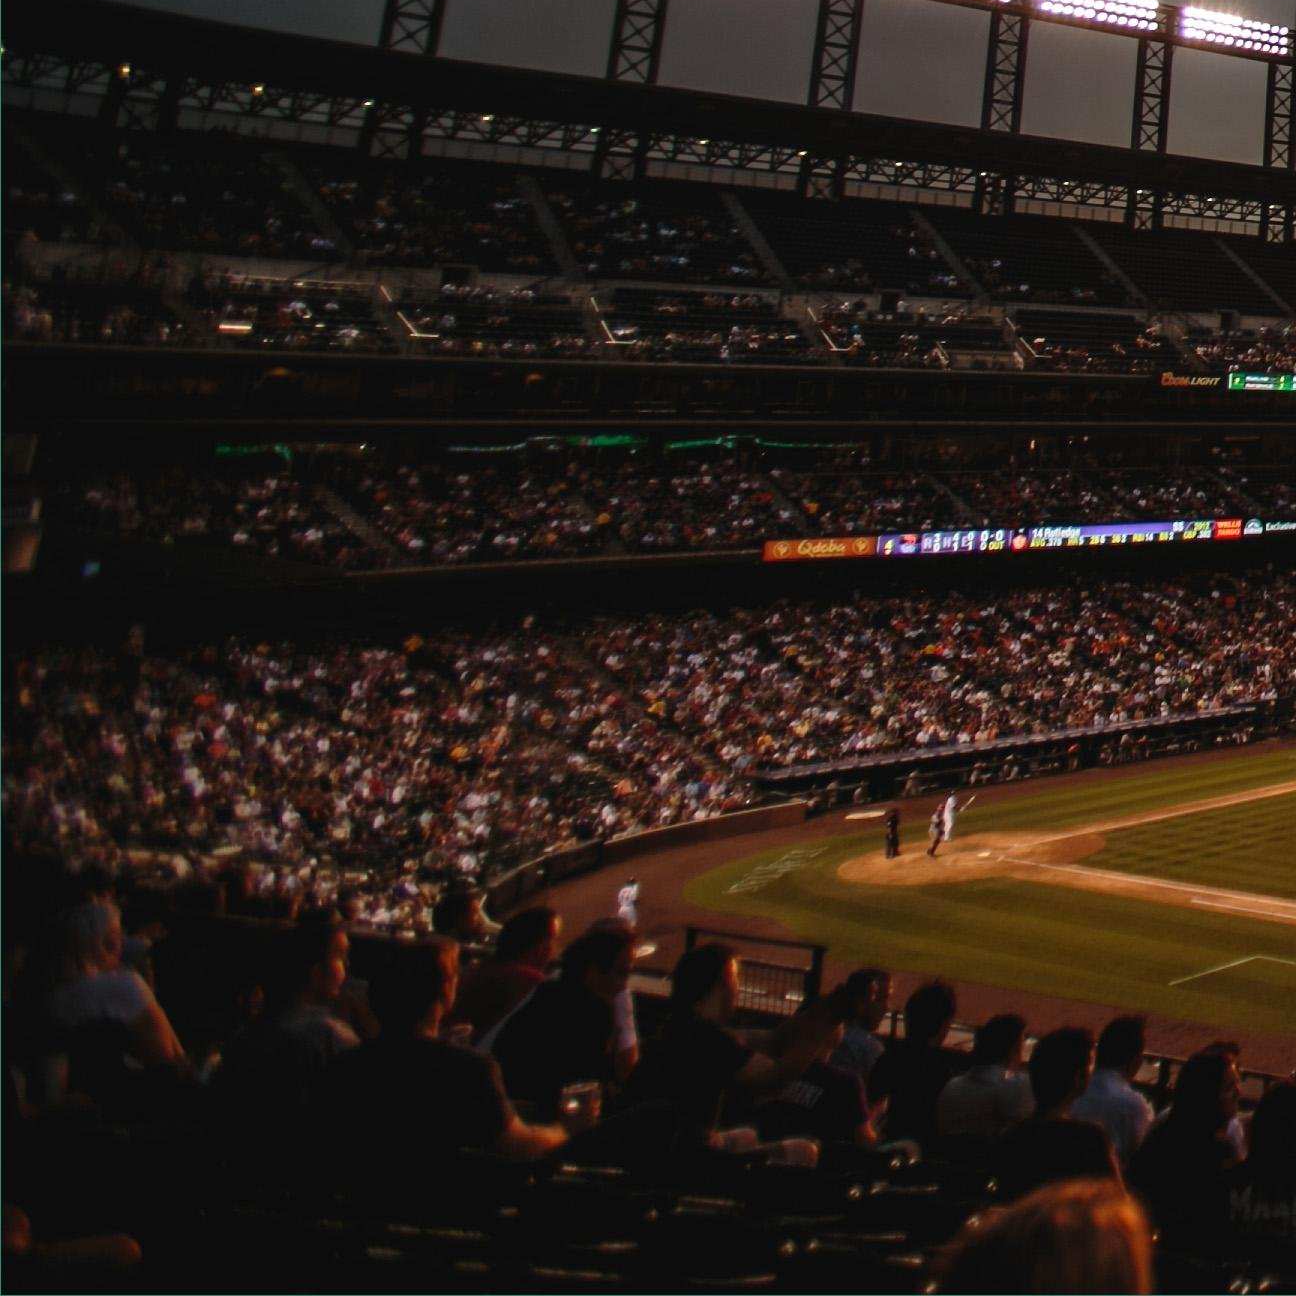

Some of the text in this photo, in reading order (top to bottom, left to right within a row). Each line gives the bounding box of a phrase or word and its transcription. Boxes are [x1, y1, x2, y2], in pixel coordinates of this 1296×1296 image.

[1191, 377, 1221, 387] LIGHT
[1265, 521, 1296, 531] Exclusive
[797, 539, 847, 556] Qdoba
